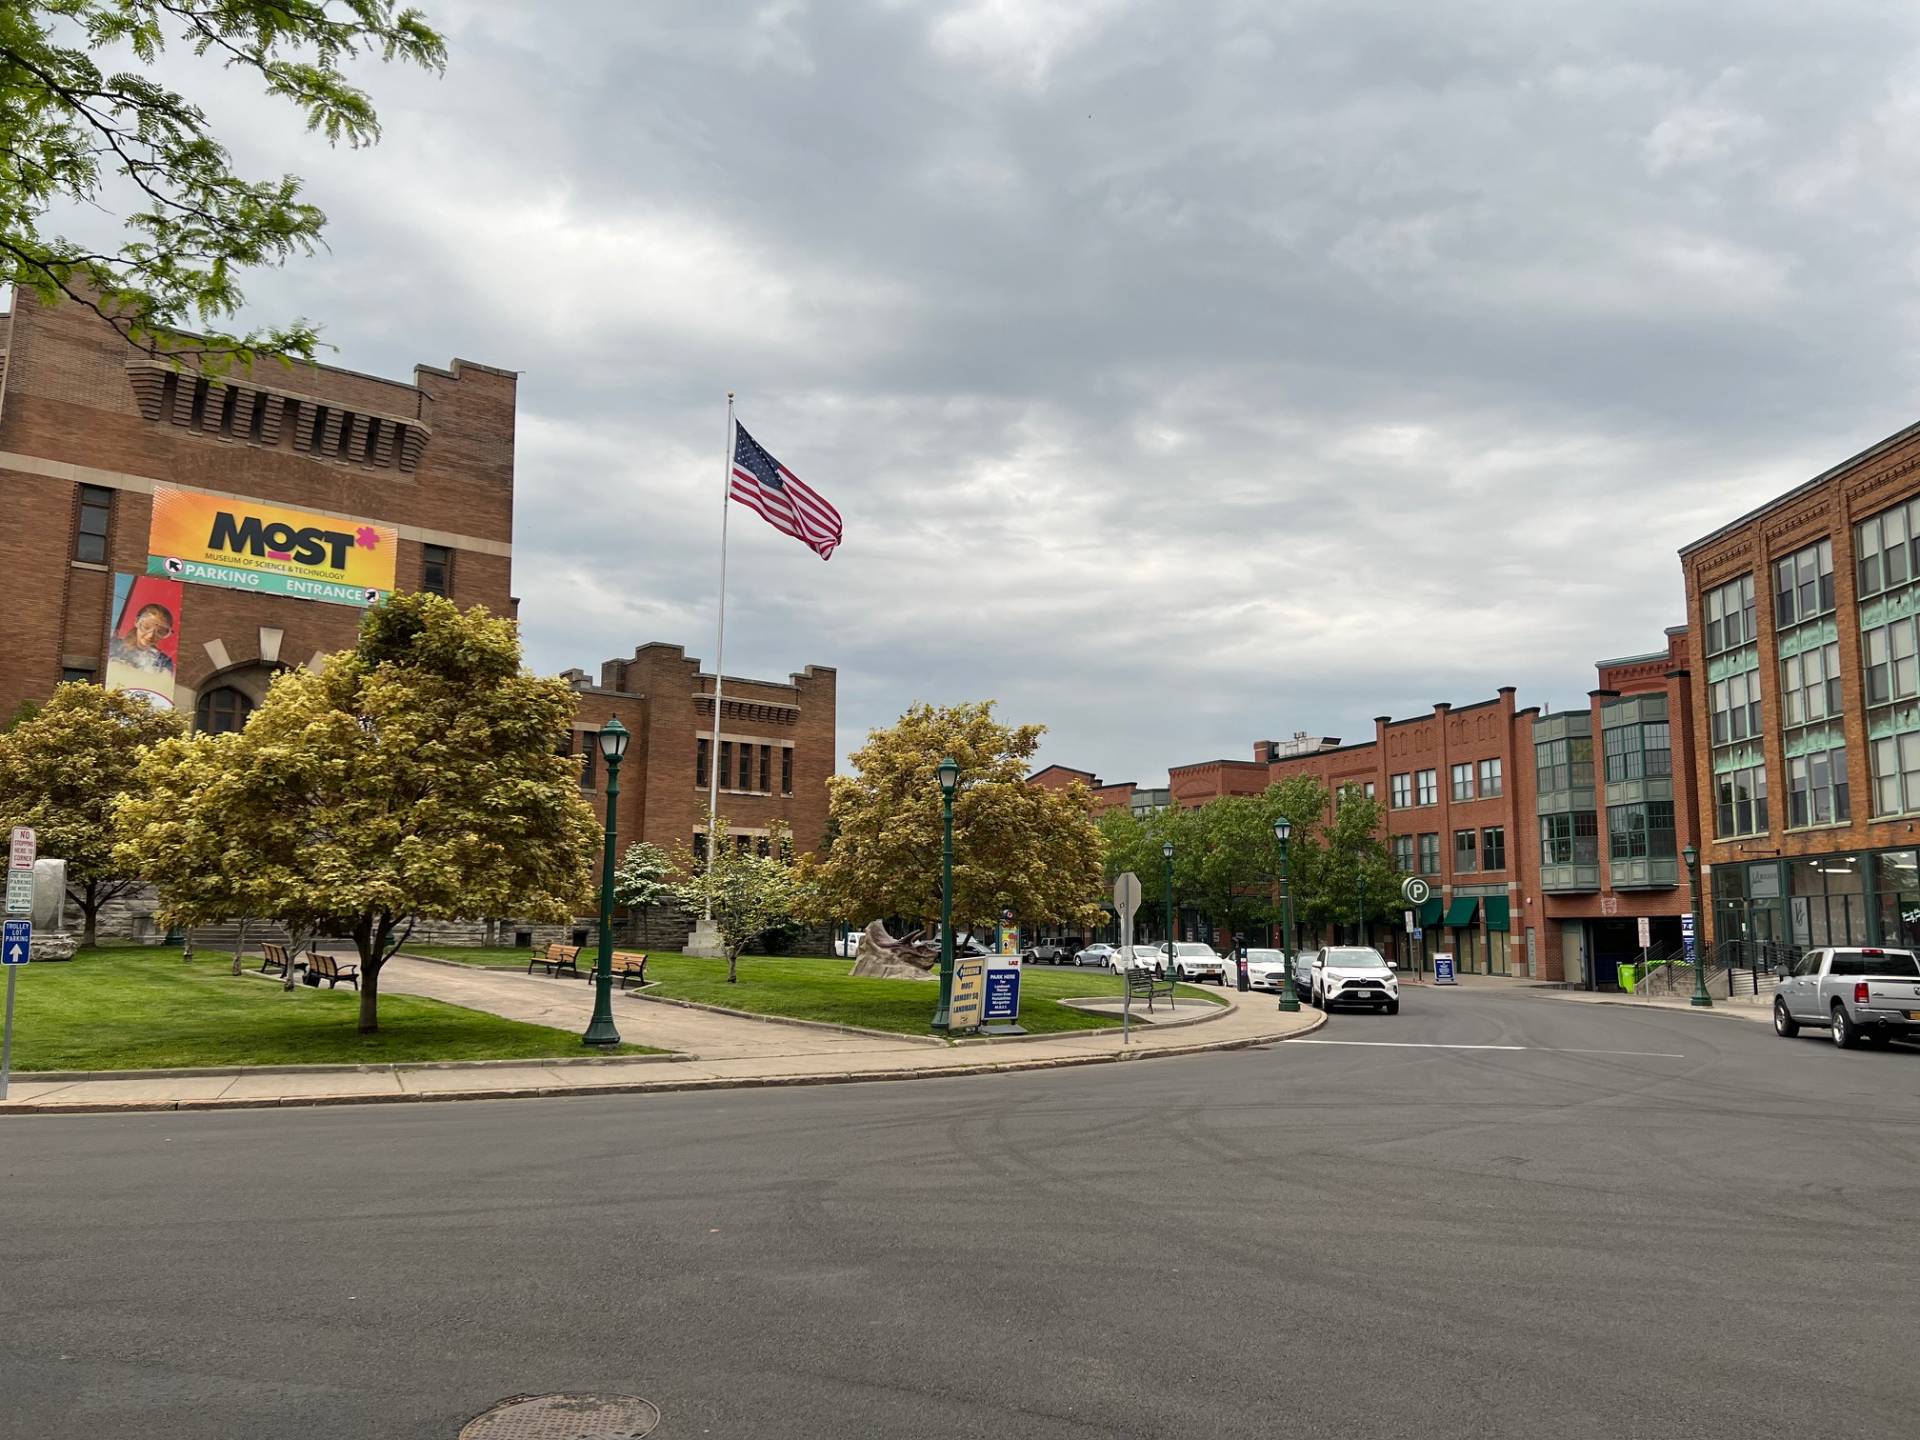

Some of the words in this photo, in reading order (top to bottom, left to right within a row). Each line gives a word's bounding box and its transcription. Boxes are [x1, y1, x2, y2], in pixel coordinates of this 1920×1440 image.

[208, 511, 355, 570] MOST
[205, 552, 241, 563] MUSEUM
[242, 558, 254, 566] OF
[255, 560, 286, 572] SCIENCE
[294, 566, 345, 580] TECHNOLOGY
[185, 565, 260, 585] PARKING
[287, 580, 362, 601] ENTRANCE
[20, 831, 30, 839] NO
[1413, 885, 1423, 898] P
[961, 982, 974, 990] MOST
[953, 1004, 977, 1013] LANDMARK
